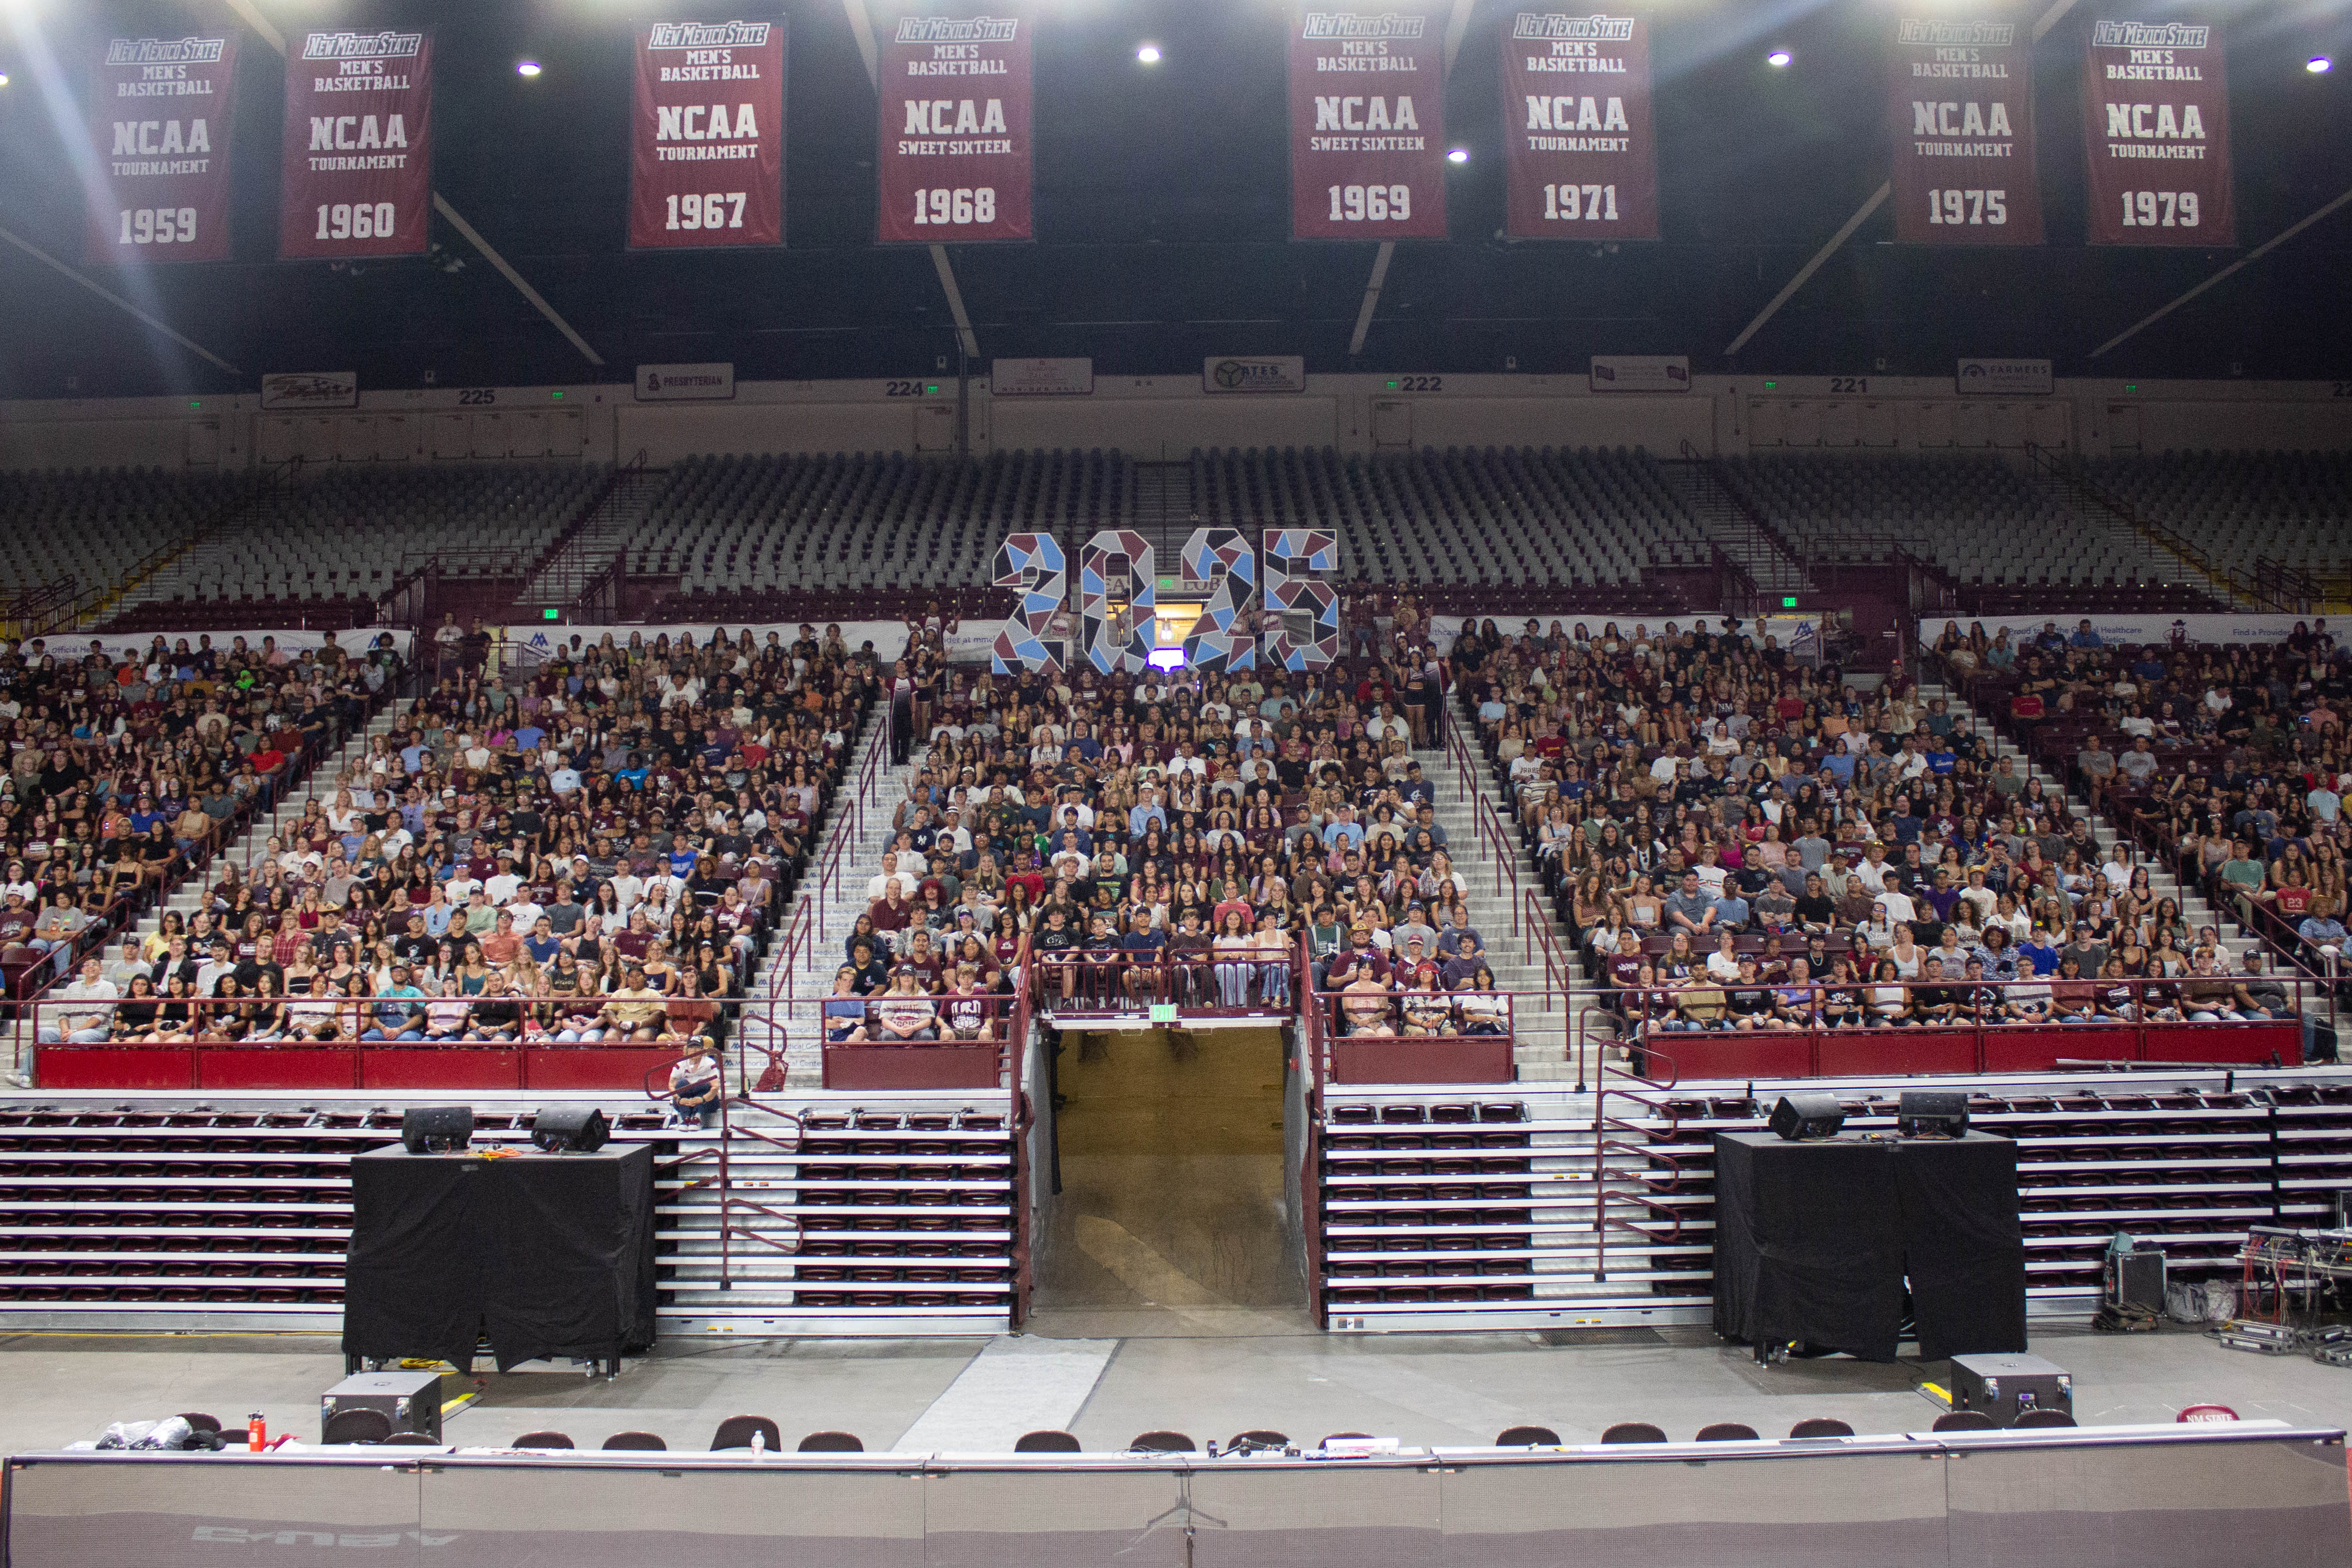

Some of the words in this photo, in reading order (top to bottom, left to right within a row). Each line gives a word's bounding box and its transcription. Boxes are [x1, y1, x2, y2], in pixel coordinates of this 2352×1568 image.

[933, 45, 979, 59] MEN'S
[1342, 41, 1388, 55] MEN'S
[1552, 42, 1597, 56] MEN'S
[1936, 48, 1979, 61] MEN'S
[686, 49, 731, 65] MEN'S
[1317, 57, 1417, 71] BASKETBALL
[1527, 57, 1626, 72] BASKETBALL
[2130, 50, 2173, 64] MEN'S
[143, 66, 186, 79] MEN'S
[340, 61, 383, 75] MEN'S
[660, 65, 760, 81] BASKETBALL
[908, 60, 1007, 75] BASKETBALL
[1913, 63, 2008, 78] BASKETBALL
[2107, 65, 2202, 81] BASKETBALL
[118, 80, 213, 97] BASKETBALL
[314, 75, 410, 92] BASKETBALL
[904, 99, 1006, 134] NCAA
[1315, 96, 1418, 131] NCAA
[1526, 96, 1629, 131] NCAA
[1913, 102, 2012, 136] NCAA
[2107, 104, 2205, 138] NCAA
[656, 104, 758, 140] NCAA
[112, 119, 210, 155] NCAA
[309, 114, 407, 150] NCAA
[899, 141, 947, 155] SWEET
[949, 141, 1011, 154] SIXTEEN
[1311, 137, 1360, 150] SWEET
[1362, 137, 1424, 150] SIXTEEN
[1528, 137, 1629, 151] TOURNAMENT
[1915, 142, 2012, 157] TOURNAMENT
[657, 145, 758, 161] TOURNAMENT
[2108, 144, 2205, 159] TOURNAMENT
[112, 160, 209, 175] TOURNAMENT
[309, 155, 407, 171] TOURNAMENT
[914, 188, 995, 224] 1968
[1329, 185, 1410, 220] 1969
[1544, 184, 1618, 219] 1971
[1929, 190, 2007, 224] 1975
[666, 193, 746, 229] 1967
[2123, 192, 2199, 227] 1979
[119, 207, 196, 244] 1959
[316, 203, 394, 239] 1960
[1990, 365, 2047, 374] FARMERS
[664, 376, 722, 386] PRESBYTERIAN
[886, 381, 923, 396] 224
[1402, 376, 1441, 391] 222
[1831, 377, 1866, 392] 221
[459, 390, 495, 405] 225
[1784, 597, 1796, 606] EXIT
[2287, 898, 2303, 907] 23
[1153, 1005, 1173, 1022] EXIT
[2205, 1414, 2232, 1422] STATE
